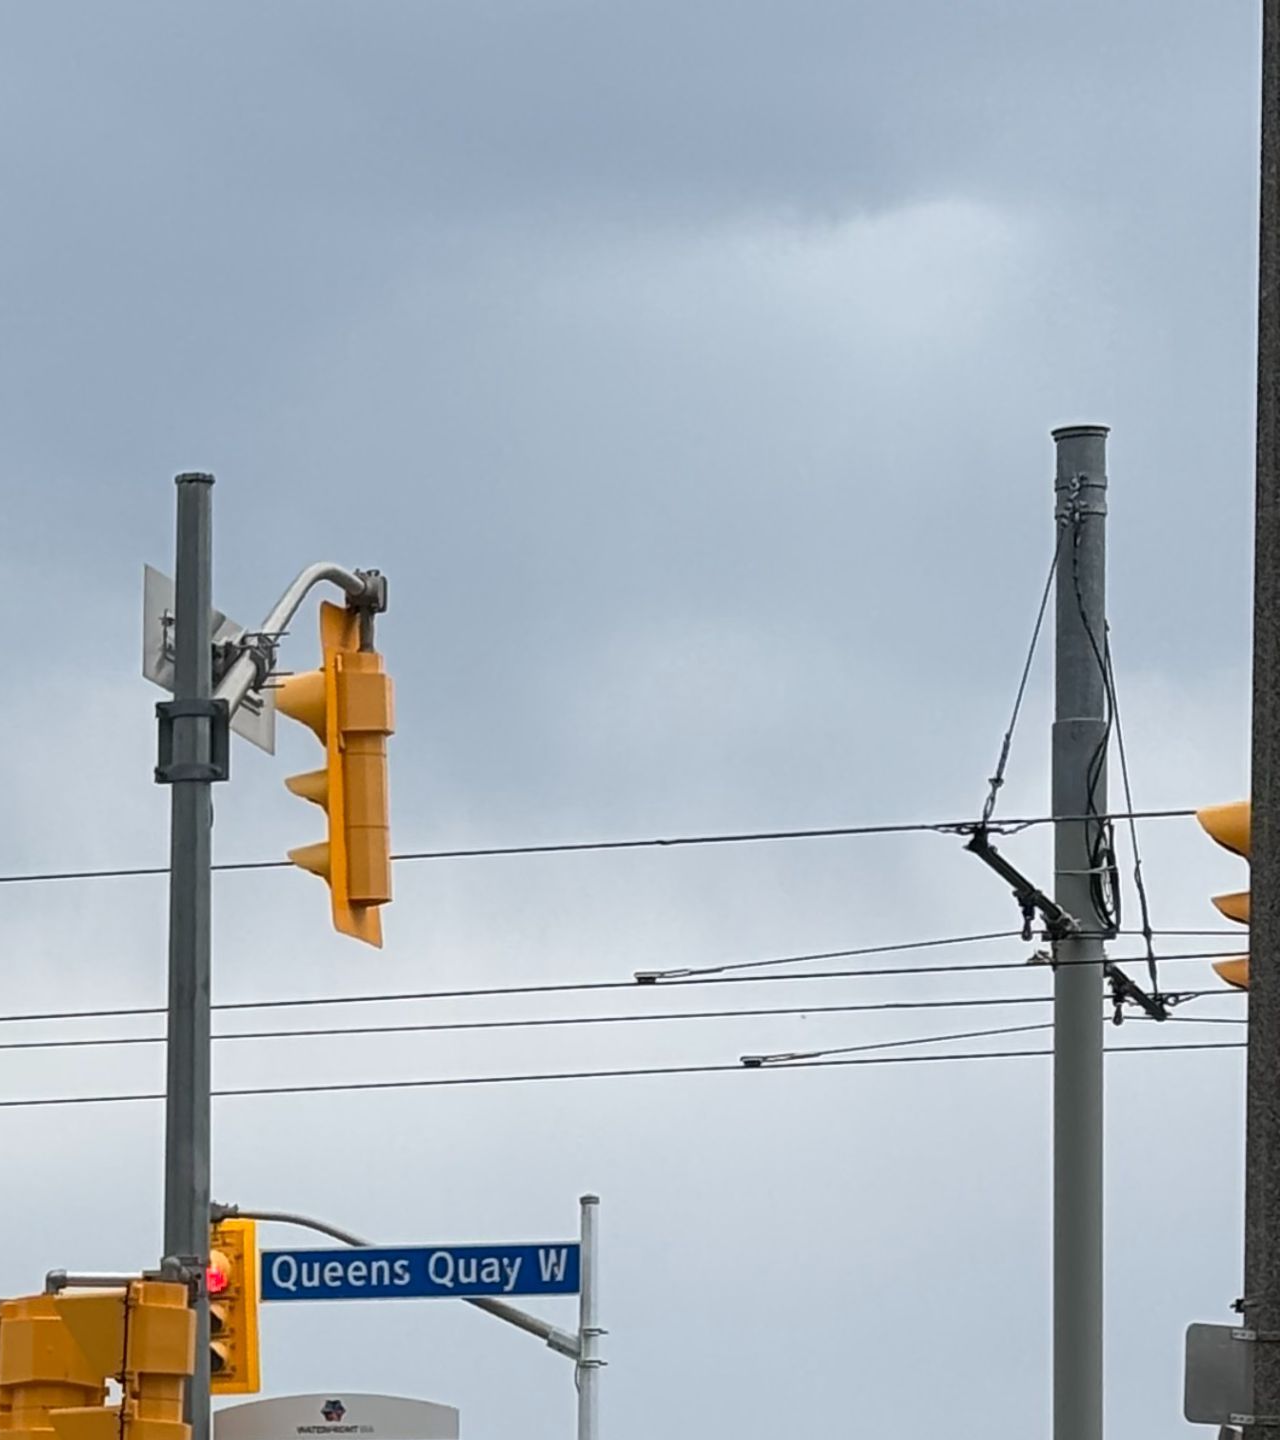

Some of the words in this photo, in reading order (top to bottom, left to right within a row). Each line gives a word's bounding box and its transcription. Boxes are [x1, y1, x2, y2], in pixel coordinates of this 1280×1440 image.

[271, 1254, 411, 1291] Queens
[428, 1249, 522, 1292] Quay
[539, 1248, 568, 1282] W
